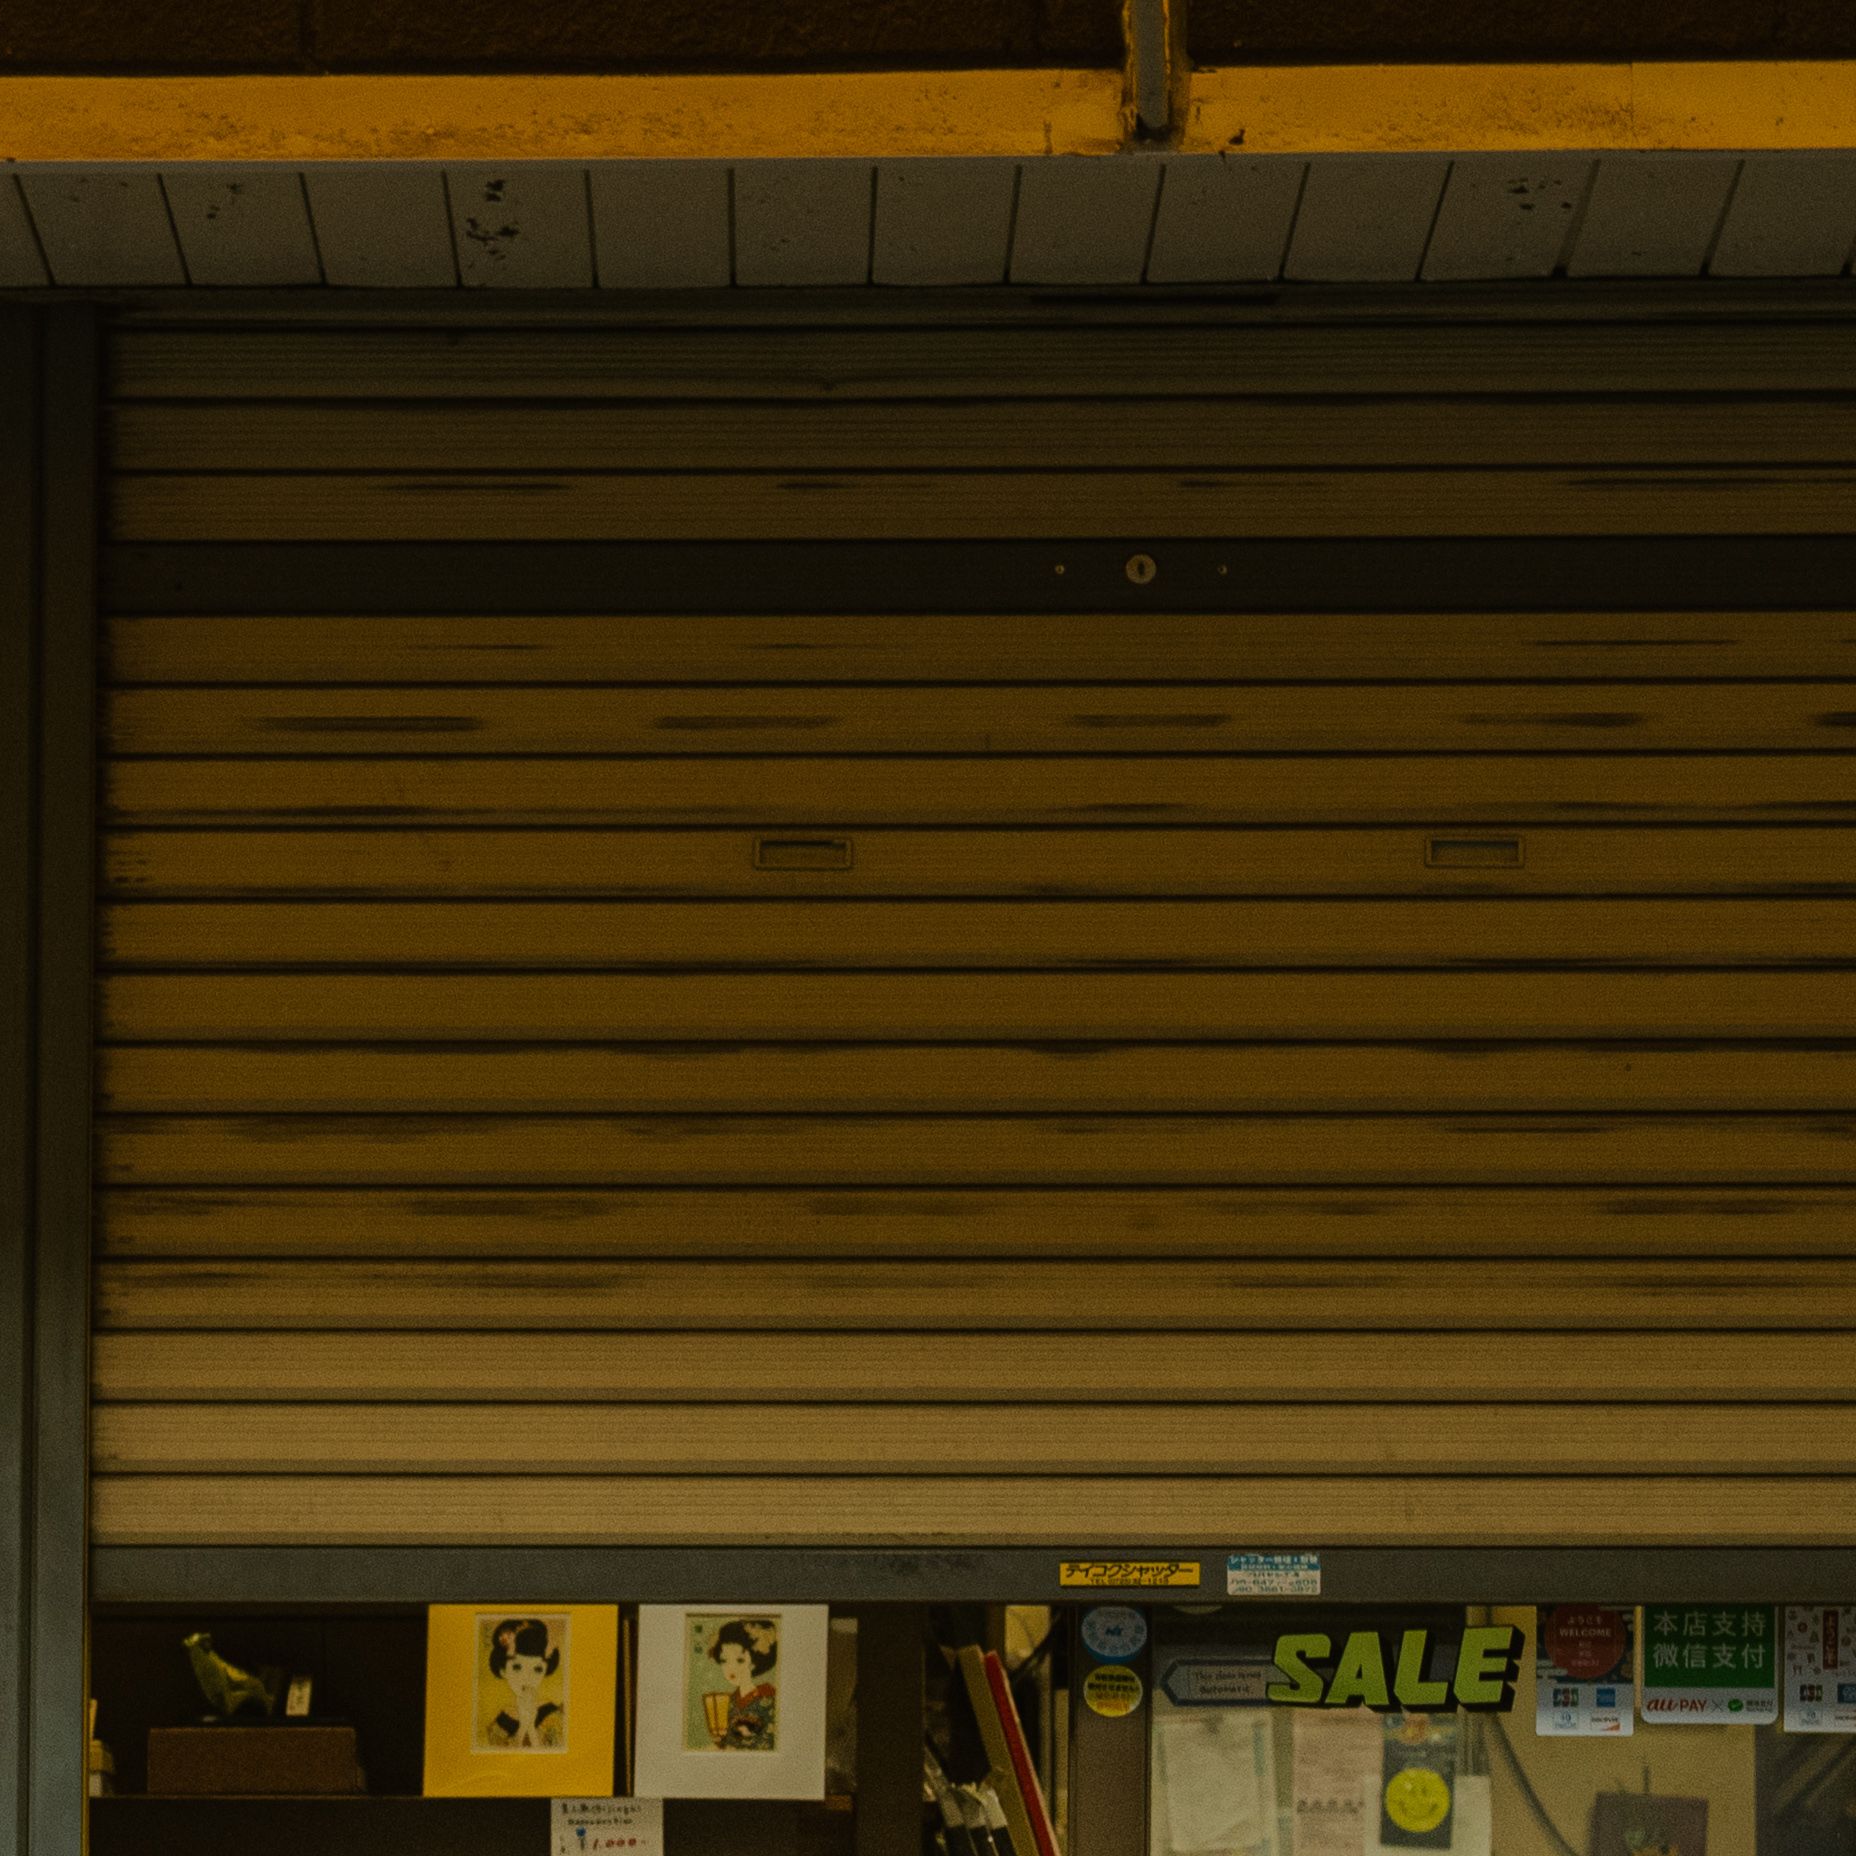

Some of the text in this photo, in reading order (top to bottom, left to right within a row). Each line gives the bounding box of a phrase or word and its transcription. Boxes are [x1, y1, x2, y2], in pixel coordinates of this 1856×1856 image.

[1065, 1563, 1194, 1579] テイコクシャッター
[1559, 1627, 1612, 1638] WELCOME
[1652, 1610, 1767, 1637] 本店支持
[1652, 1643, 1766, 1669] 微信支付
[1267, 1626, 1521, 1710] SALE
[1646, 1699, 1707, 1713] au PAY
